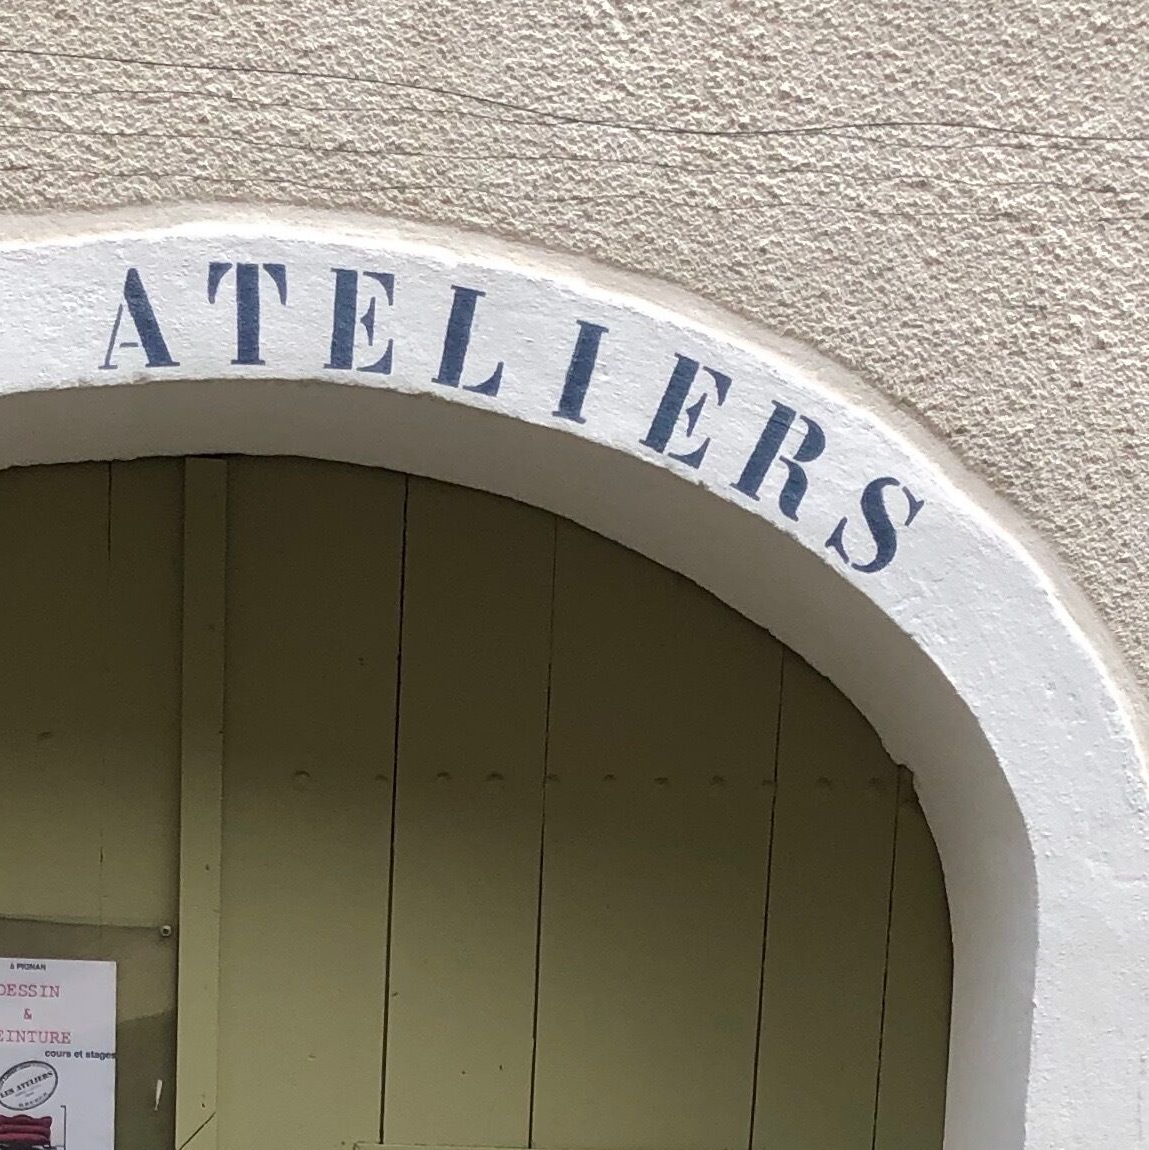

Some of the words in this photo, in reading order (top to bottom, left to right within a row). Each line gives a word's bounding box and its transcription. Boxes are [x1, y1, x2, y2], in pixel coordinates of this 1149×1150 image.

[98, 262, 925, 574] ATELIERS
[23, 1008, 32, 1020] &
[74, 1050, 83, 1059] et
